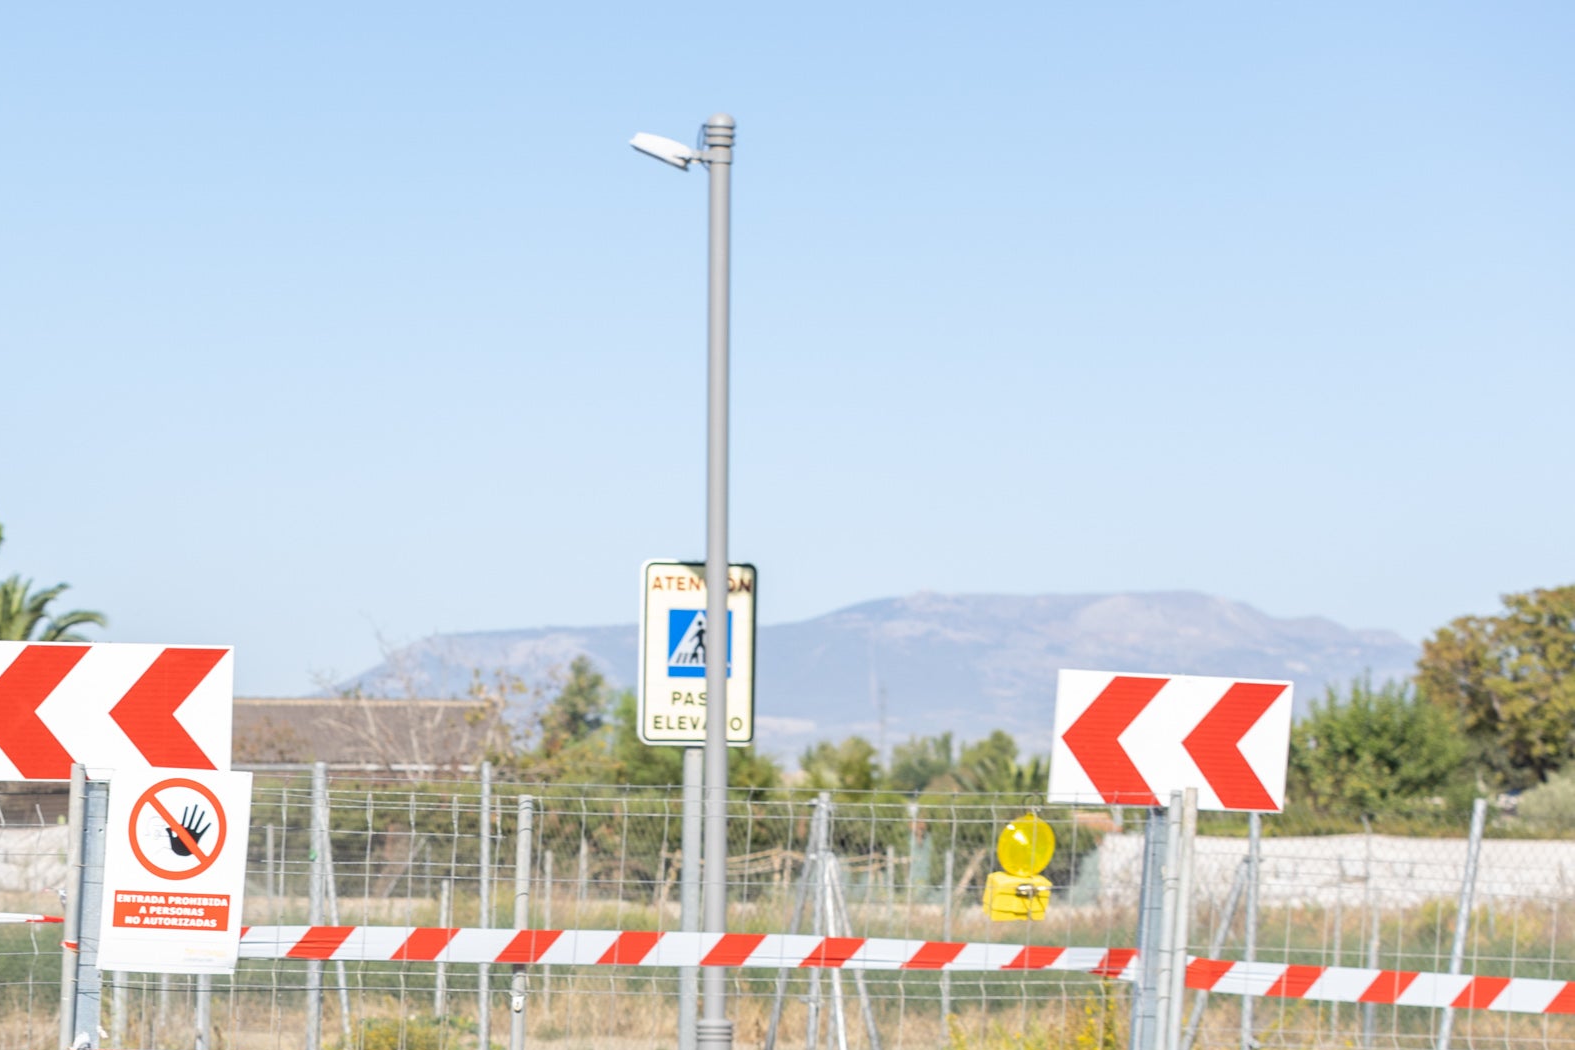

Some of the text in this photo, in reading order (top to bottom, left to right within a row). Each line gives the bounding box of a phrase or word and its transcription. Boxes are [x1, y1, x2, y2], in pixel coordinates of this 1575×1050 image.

[672, 692, 707, 705] PAS
[653, 716, 743, 731] ELEVO
[116, 894, 228, 907] ENTRADA PROHIBIDA
[139, 906, 204, 916] A PERSONAS
[124, 916, 217, 927] NO AUTORIZADAS
